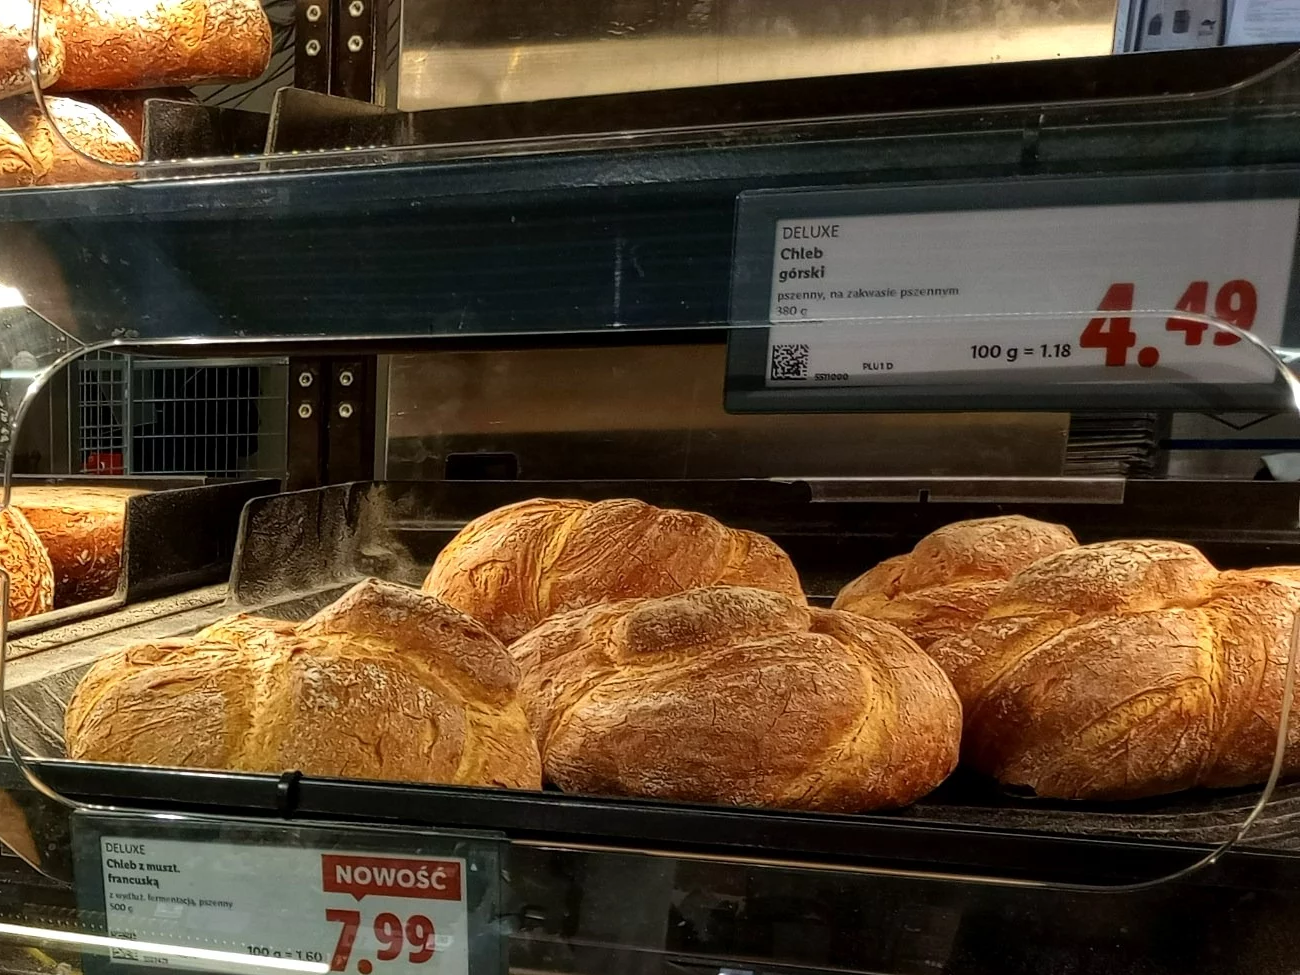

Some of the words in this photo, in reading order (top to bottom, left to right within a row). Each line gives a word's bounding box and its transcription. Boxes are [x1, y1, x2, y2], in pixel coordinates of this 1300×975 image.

[783, 225, 840, 240] DELUXE
[780, 247, 824, 260] Chleb
[778, 266, 825, 283] górski
[777, 290, 826, 302] pszenny,
[830, 290, 844, 299] na
[847, 288, 896, 298] zakwasie
[900, 287, 959, 299] pszennym
[777, 306, 797, 316] 380
[1079, 279, 1257, 368] 4.49
[971, 345, 1001, 359] 100
[1007, 348, 1017, 363] g
[1024, 348, 1034, 356] =
[1040, 344, 1071, 358] 1.18
[105, 842, 146, 855] DELUXE
[107, 859, 137, 870] Chleb
[139, 863, 145, 871] z
[147, 864, 180, 873] muszt.
[108, 873, 160, 889] francuską
[335, 864, 447, 891] NOWOŚĆ
[109, 903, 126, 911] 500
[199, 899, 234, 909] pszenny
[325, 908, 436, 975] 7.99
[247, 945, 270, 957] 100
